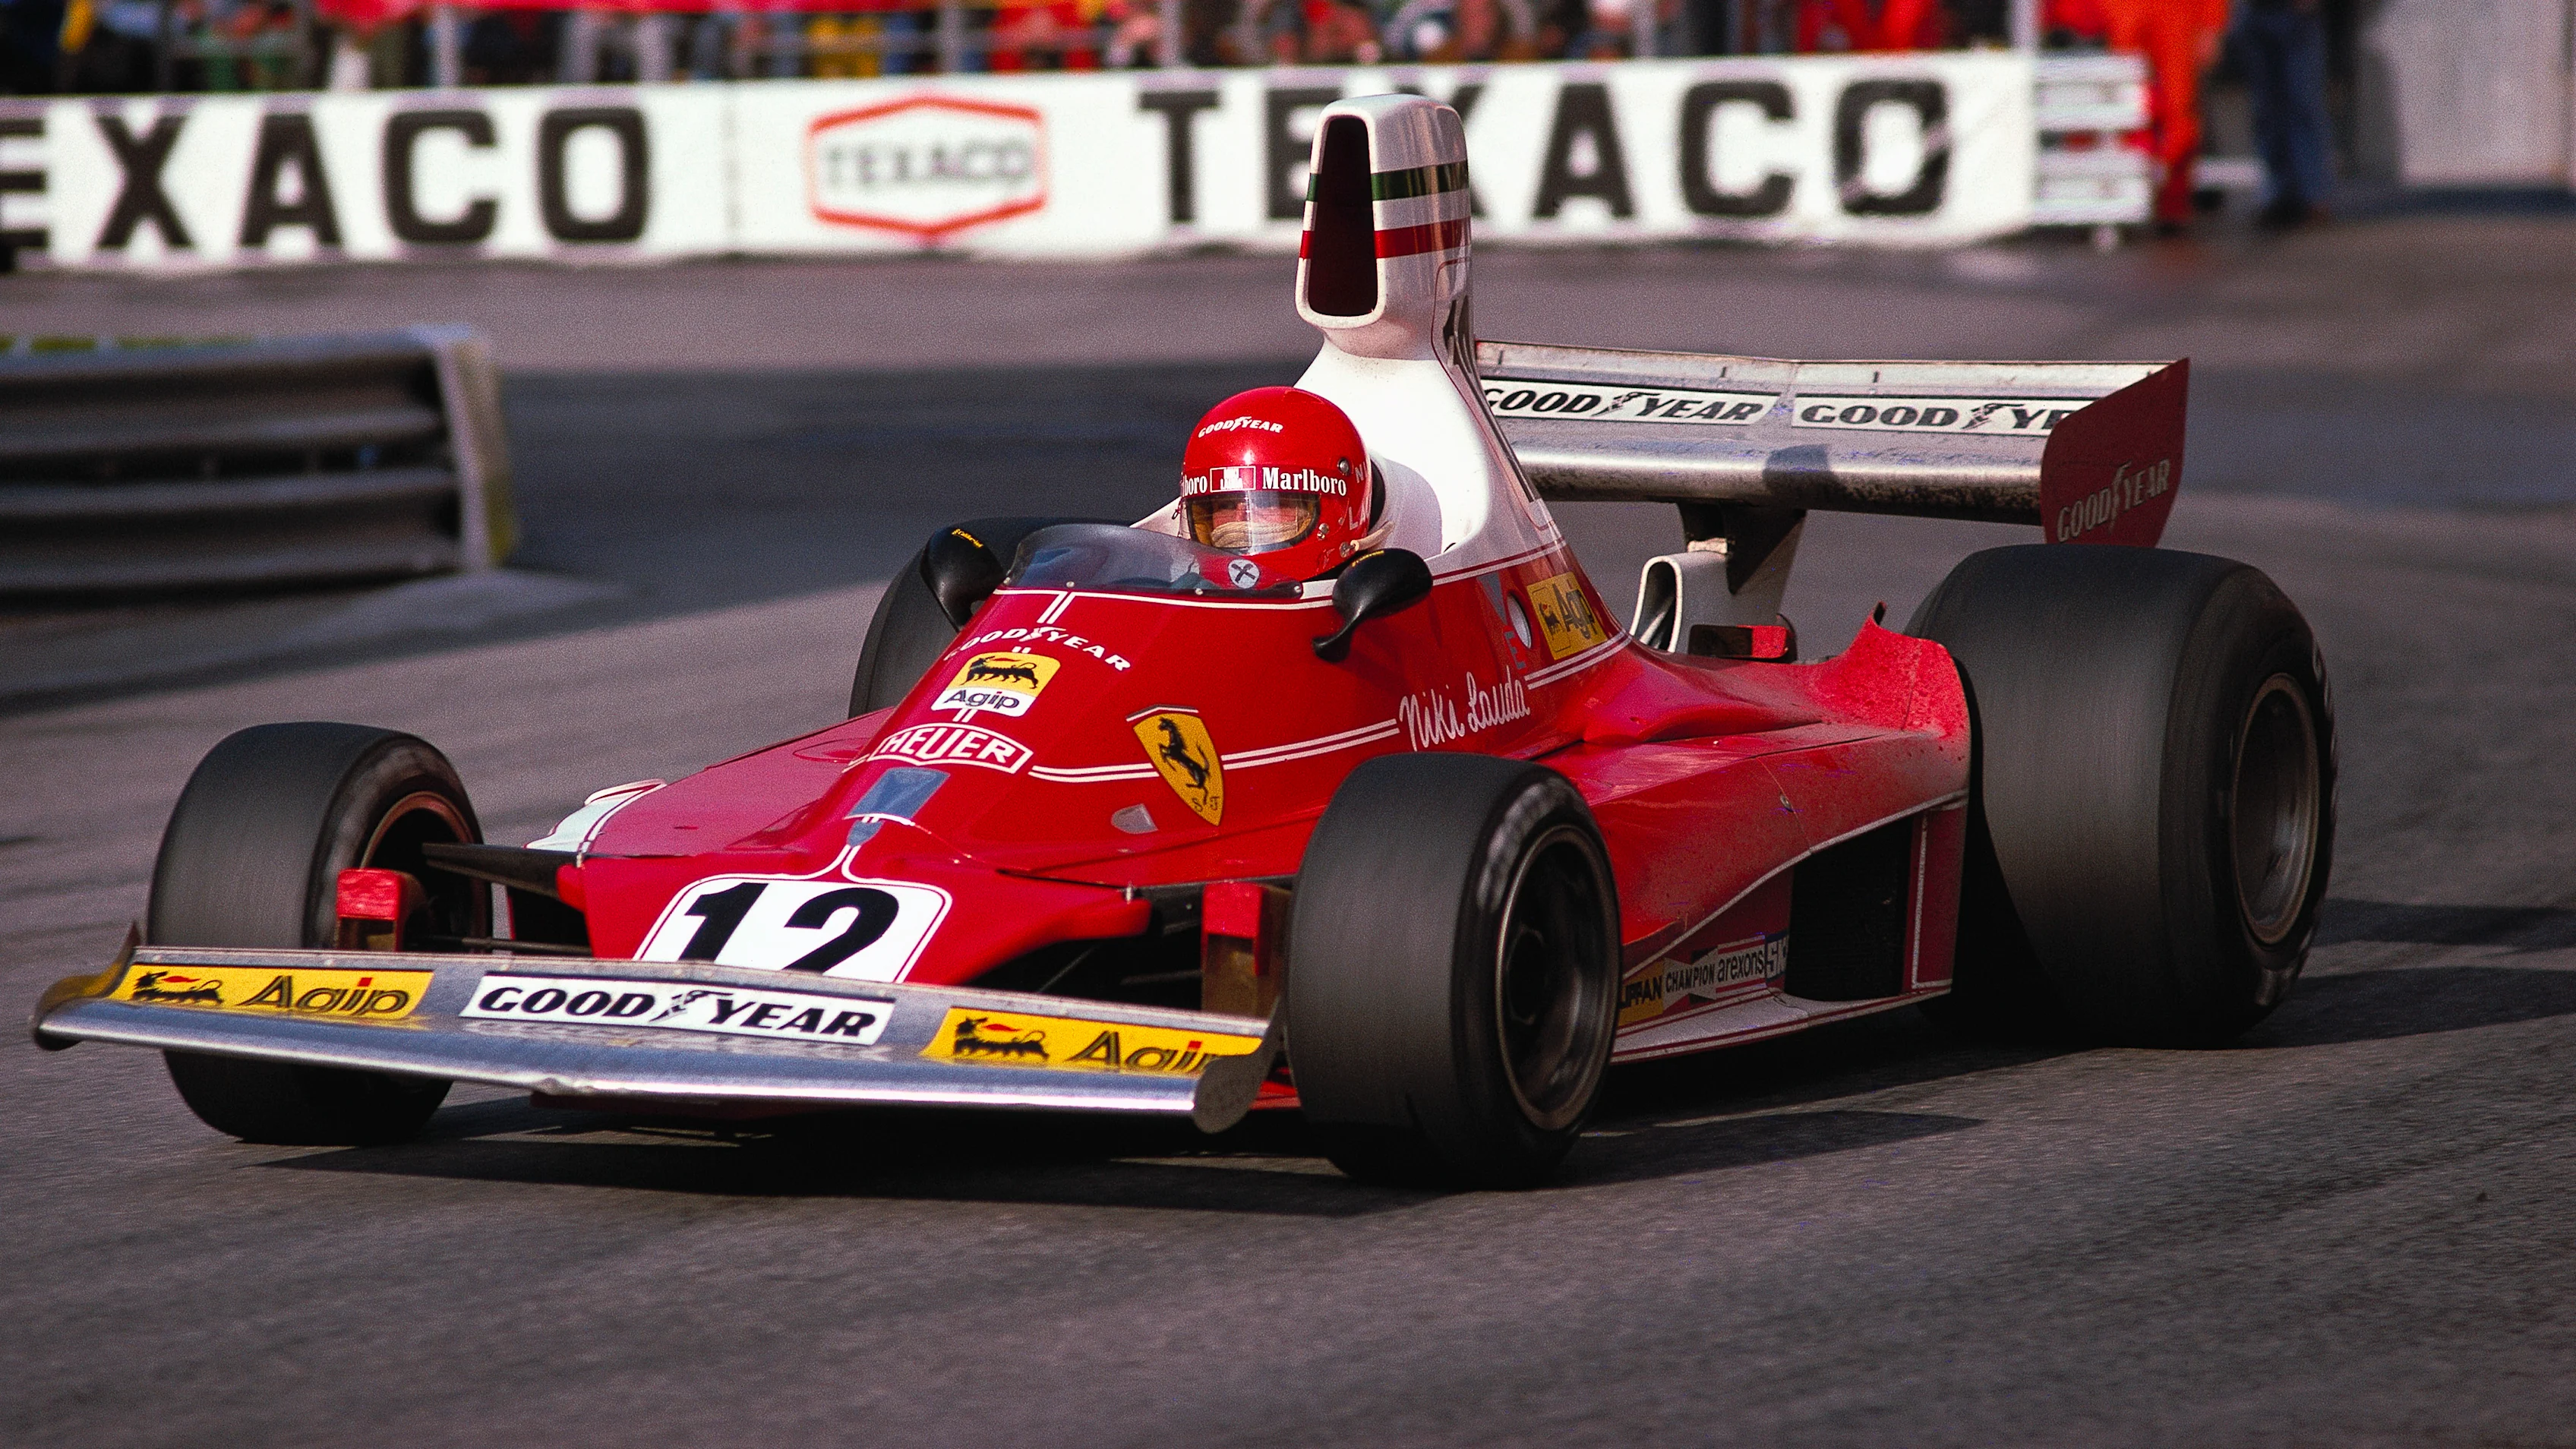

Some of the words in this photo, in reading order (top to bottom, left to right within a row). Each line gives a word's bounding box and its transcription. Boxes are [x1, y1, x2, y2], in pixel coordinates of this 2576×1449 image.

[825, 140, 1034, 188] TEXACO
[1138, 80, 1952, 222] TEACO
[0, 109, 651, 248] EXACO
[1261, 466, 1347, 496] Marlboro
[944, 690, 1020, 710] Agip
[1399, 684, 1465, 752] Niki
[1467, 665, 1530, 733] Lauda
[878, 727, 1015, 765] HEUER
[679, 882, 899, 973] 12
[1665, 962, 1715, 993] CHAMPION
[1717, 949, 1764, 983] arexons
[1766, 937, 1788, 978] SK
[237, 975, 411, 1015] Agip
